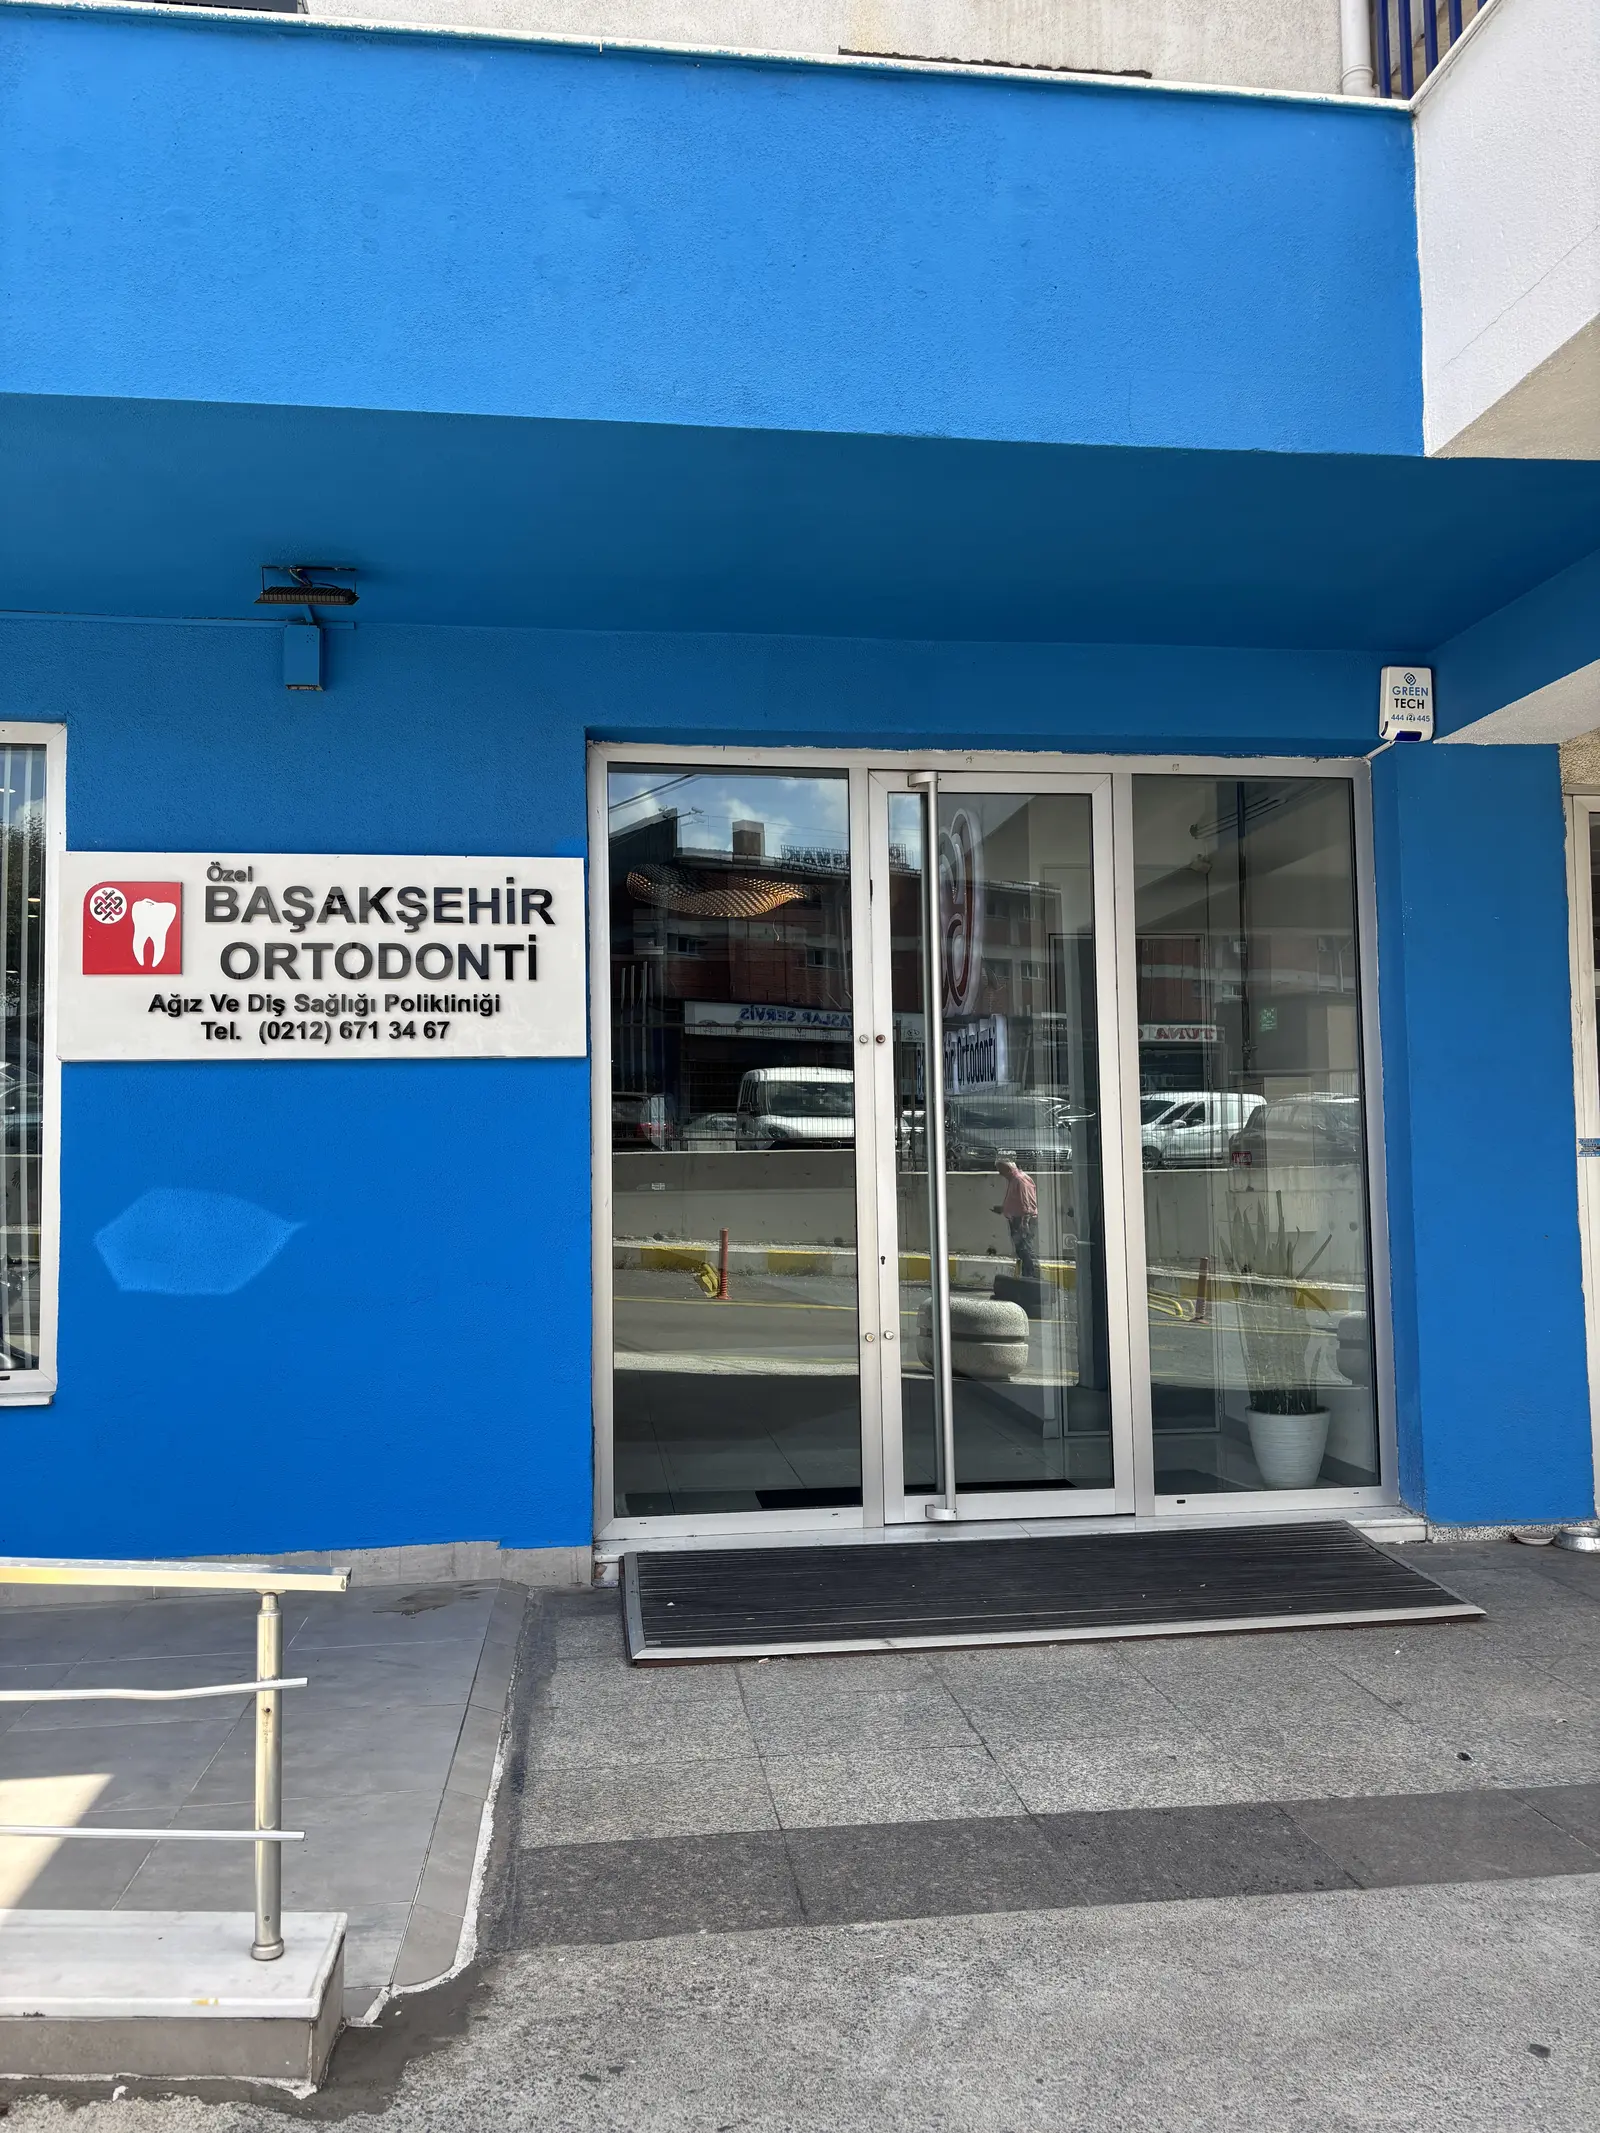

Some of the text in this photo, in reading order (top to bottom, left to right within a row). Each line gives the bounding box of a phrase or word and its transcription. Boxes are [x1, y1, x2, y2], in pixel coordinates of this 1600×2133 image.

[1392, 686, 1428, 696] GREEN
[1394, 698, 1424, 709] TECH
[1417, 714, 1430, 722] 445
[206, 861, 254, 882] Özel
[204, 877, 555, 933] BAŞAKŞEHİR
[220, 934, 538, 981] ORTODONTİ
[148, 993, 501, 1018] Ağız Ve Diş Sağlığı Polikliniği
[201, 1020, 450, 1043] Tel. (0212) 671 34 67
